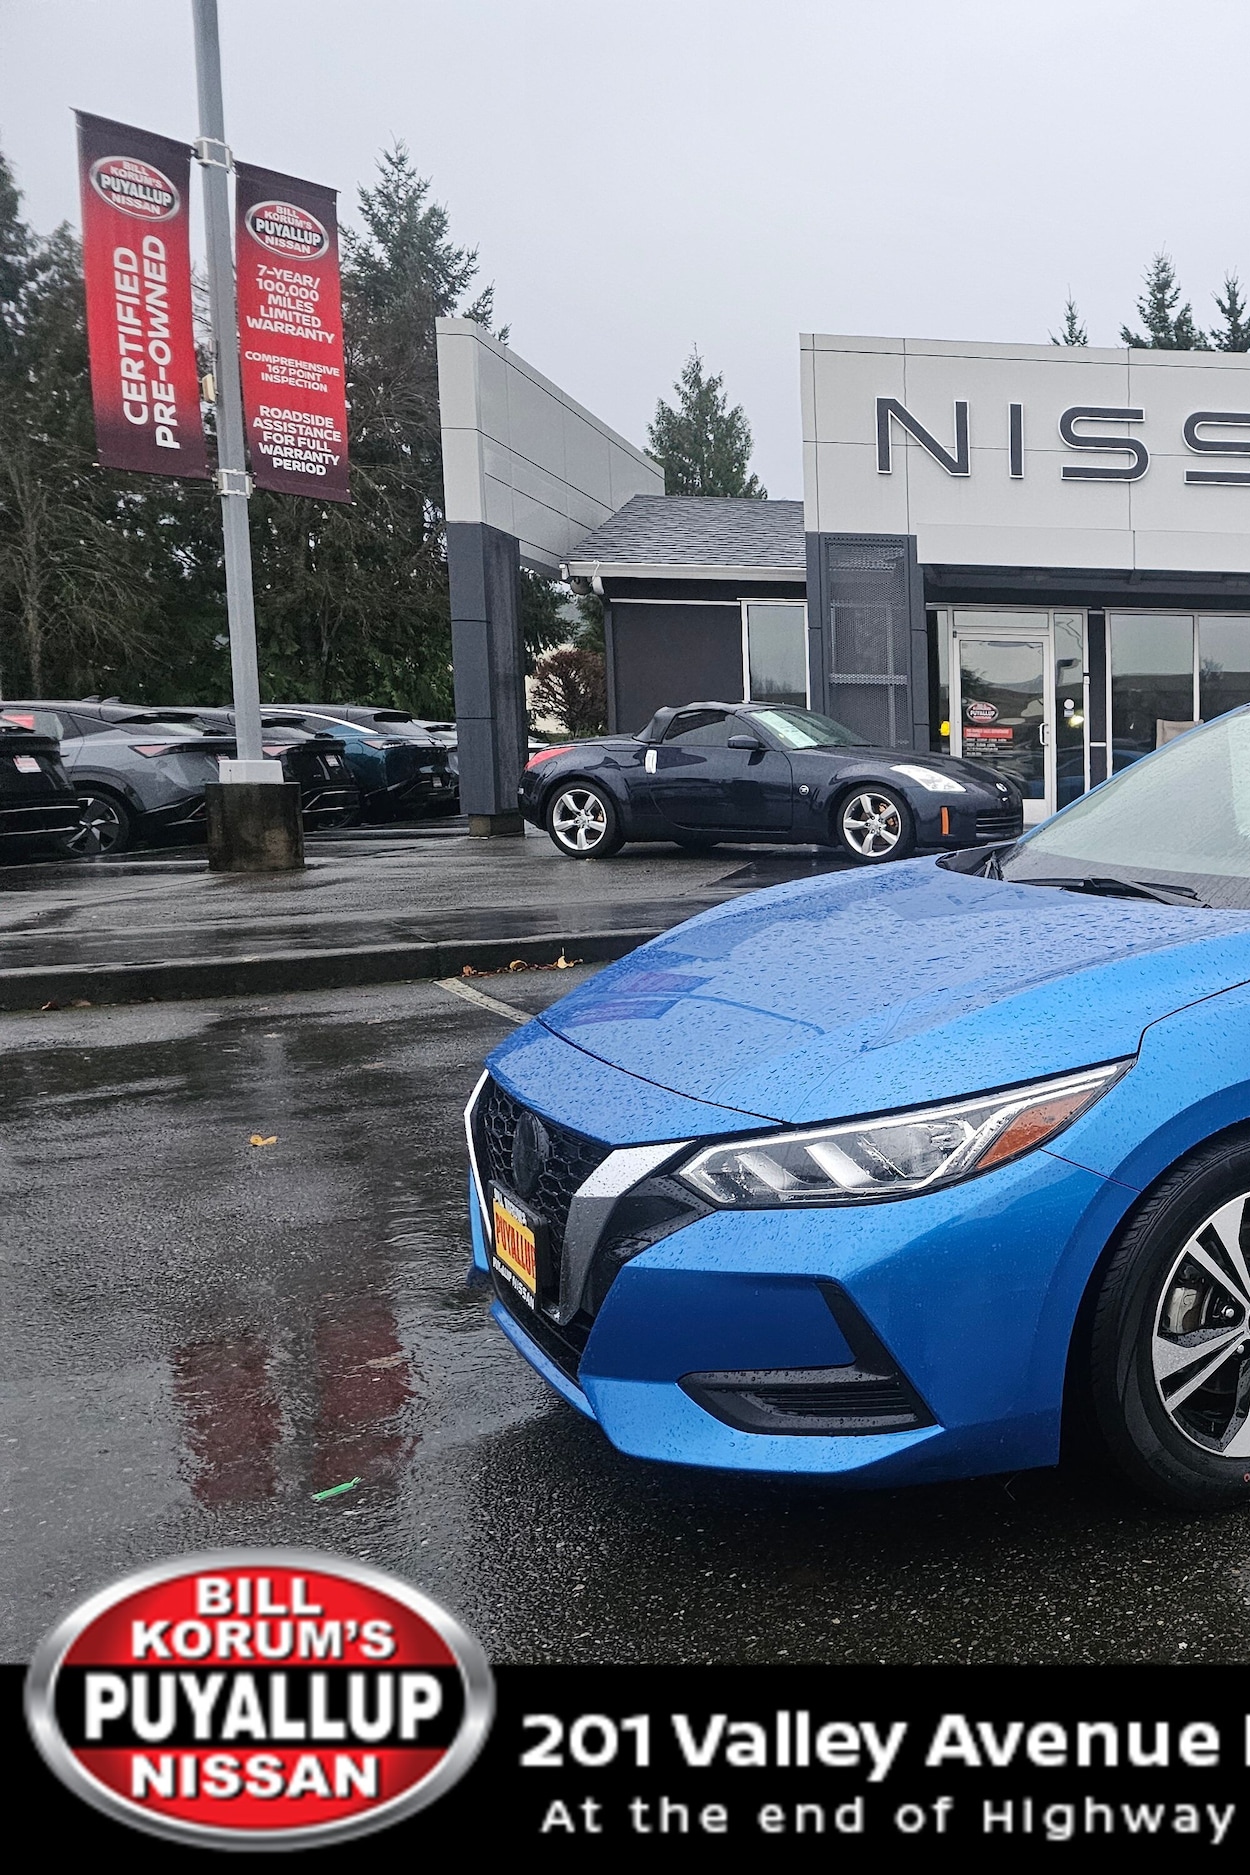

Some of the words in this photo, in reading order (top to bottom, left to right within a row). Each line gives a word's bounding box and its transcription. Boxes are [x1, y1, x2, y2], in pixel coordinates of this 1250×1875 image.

[109, 166, 163, 189] KORUM'S
[122, 160, 149, 177] BILL
[100, 173, 172, 207] PUYALLUP
[111, 192, 161, 215] NISSAN
[276, 205, 299, 219] BILL
[255, 218, 321, 247] PUYALLUP
[264, 211, 313, 230] KORUM'S
[264, 236, 311, 255] NISSAN
[257, 264, 320, 290] 7-YEAR/
[256, 278, 320, 302] 100,000
[267, 293, 315, 314] MILES
[260, 305, 322, 329] LIMITED
[113, 246, 149, 425] CERTIFIED
[246, 315, 335, 344] WARRANTY
[142, 235, 181, 450] PRE-OWNED
[245, 351, 340, 377] COMPREHENSIVE
[266, 364, 286, 375] 167
[289, 367, 322, 382] POINT
[260, 372, 328, 393] INSPECTION
[259, 405, 334, 429] ROADSIDE
[253, 417, 342, 442] ASSISTANCE
[258, 442, 340, 466] WARRANTY
[262, 431, 295, 447] FOR
[298, 437, 332, 453] FULL
[272, 457, 327, 476] PERIOD
[495, 1211, 537, 1280] PUYALLUP
